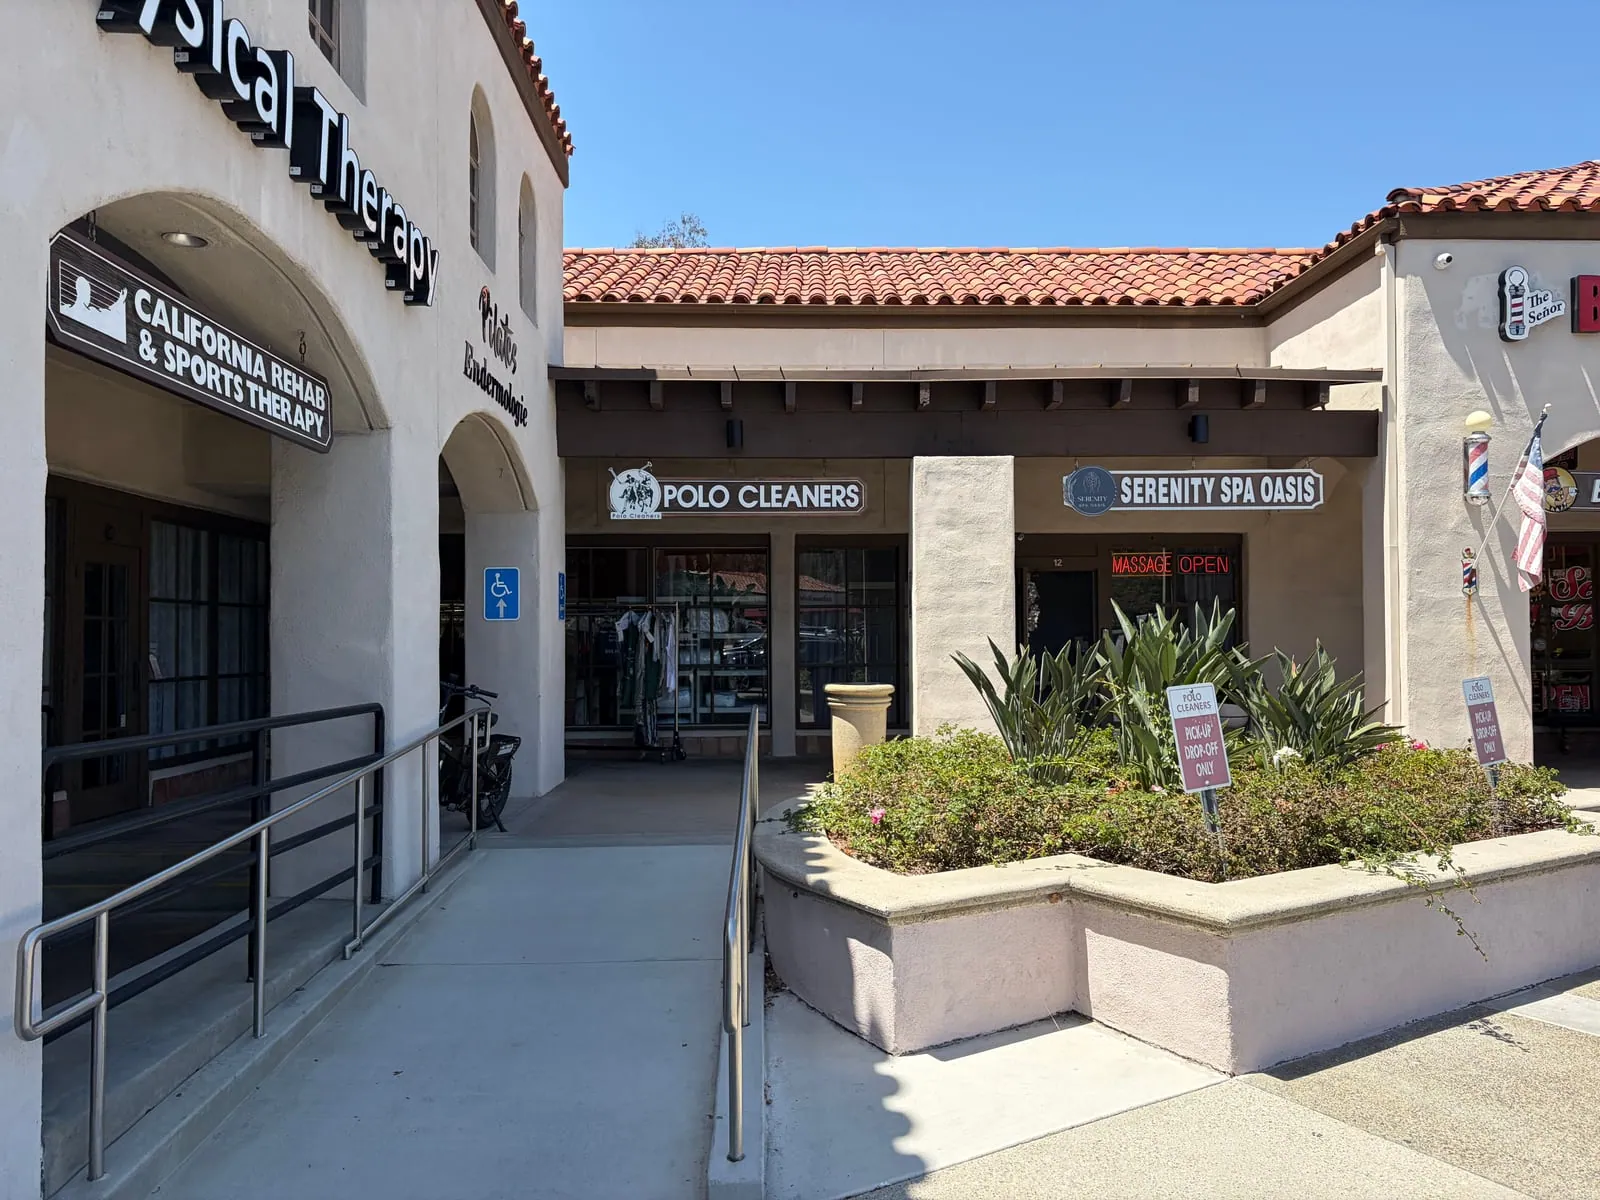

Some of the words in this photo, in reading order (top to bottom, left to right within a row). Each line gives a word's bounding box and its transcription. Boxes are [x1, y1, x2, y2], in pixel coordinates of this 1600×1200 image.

[139, 0, 294, 149] sical
[312, 86, 440, 306] Therapy
[1527, 293, 1549, 309] The
[1528, 303, 1563, 324] Señor
[478, 285, 518, 375] Pilates
[134, 288, 268, 383] CALIFORNIA
[271, 360, 326, 412] REHAB
[138, 328, 158, 365] &
[163, 340, 244, 403] SPORTS
[246, 379, 324, 438] THERAPY
[463, 340, 528, 428] Endermologie
[663, 484, 730, 509] POLO
[738, 484, 860, 509] CLEANERS
[1120, 476, 1216, 504] SERENITY
[1220, 476, 1255, 503] SPA
[1260, 475, 1315, 502] OASIS
[1053, 558, 1063, 567] 12
[1112, 554, 1172, 573] MASSAGE
[1179, 556, 1229, 573] OPEN
[1183, 693, 1202, 702] POLO
[1469, 691, 1490, 701] CLEANERS
[1176, 701, 1212, 713] CLEANERS
[1184, 724, 1212, 740] PICK-UP
[1476, 725, 1497, 740] DROP-OFF
[1184, 742, 1219, 760] DROP-OFF
[1195, 761, 1214, 777] ONLY
